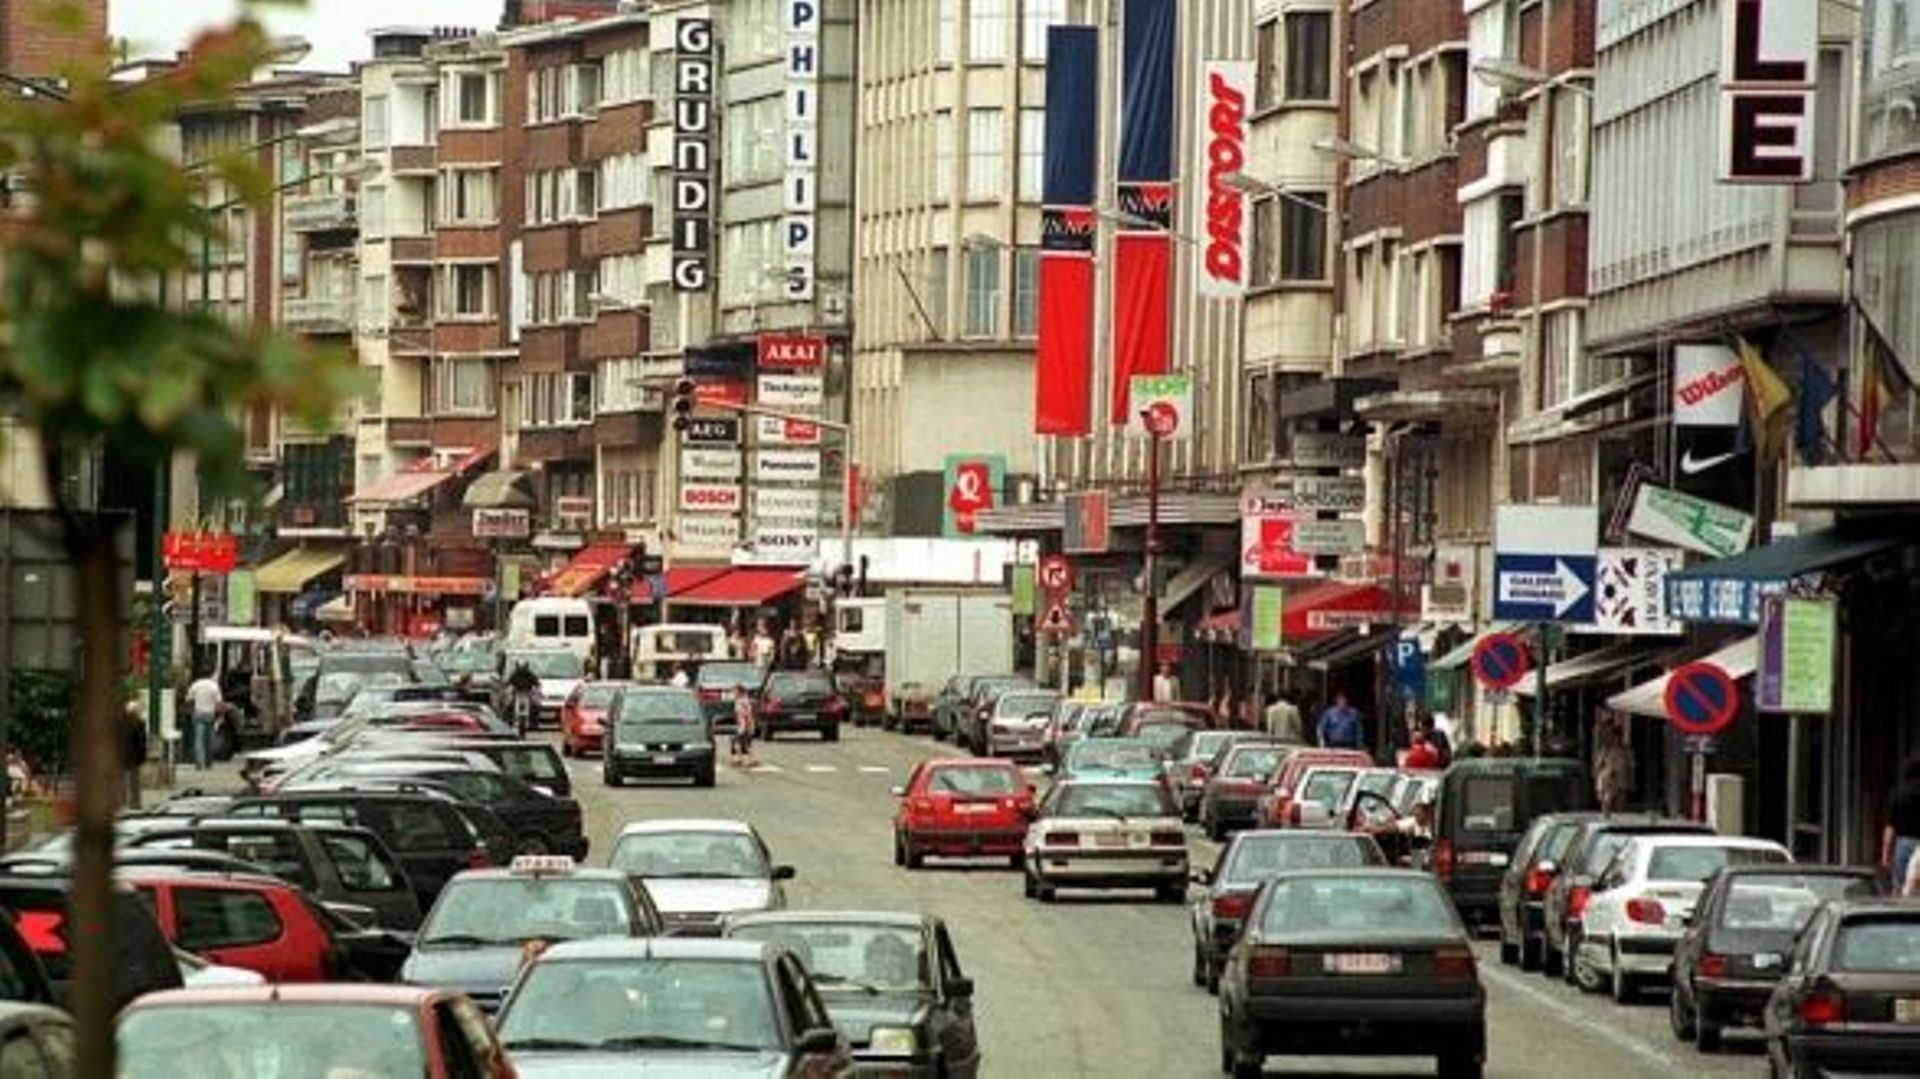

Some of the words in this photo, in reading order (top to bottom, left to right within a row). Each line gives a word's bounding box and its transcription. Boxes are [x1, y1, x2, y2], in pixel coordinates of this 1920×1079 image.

[1731, 0, 1805, 176] LE
[788, 2, 813, 292] PHILIPS
[675, 22, 709, 288] GRUNDIG
[766, 345, 816, 360] AKAI
[691, 424, 727, 437] AEG
[761, 459, 815, 470] Panasonic
[685, 489, 735, 504] BOSCH
[758, 535, 814, 547] SONY
[1397, 643, 1417, 667] P
